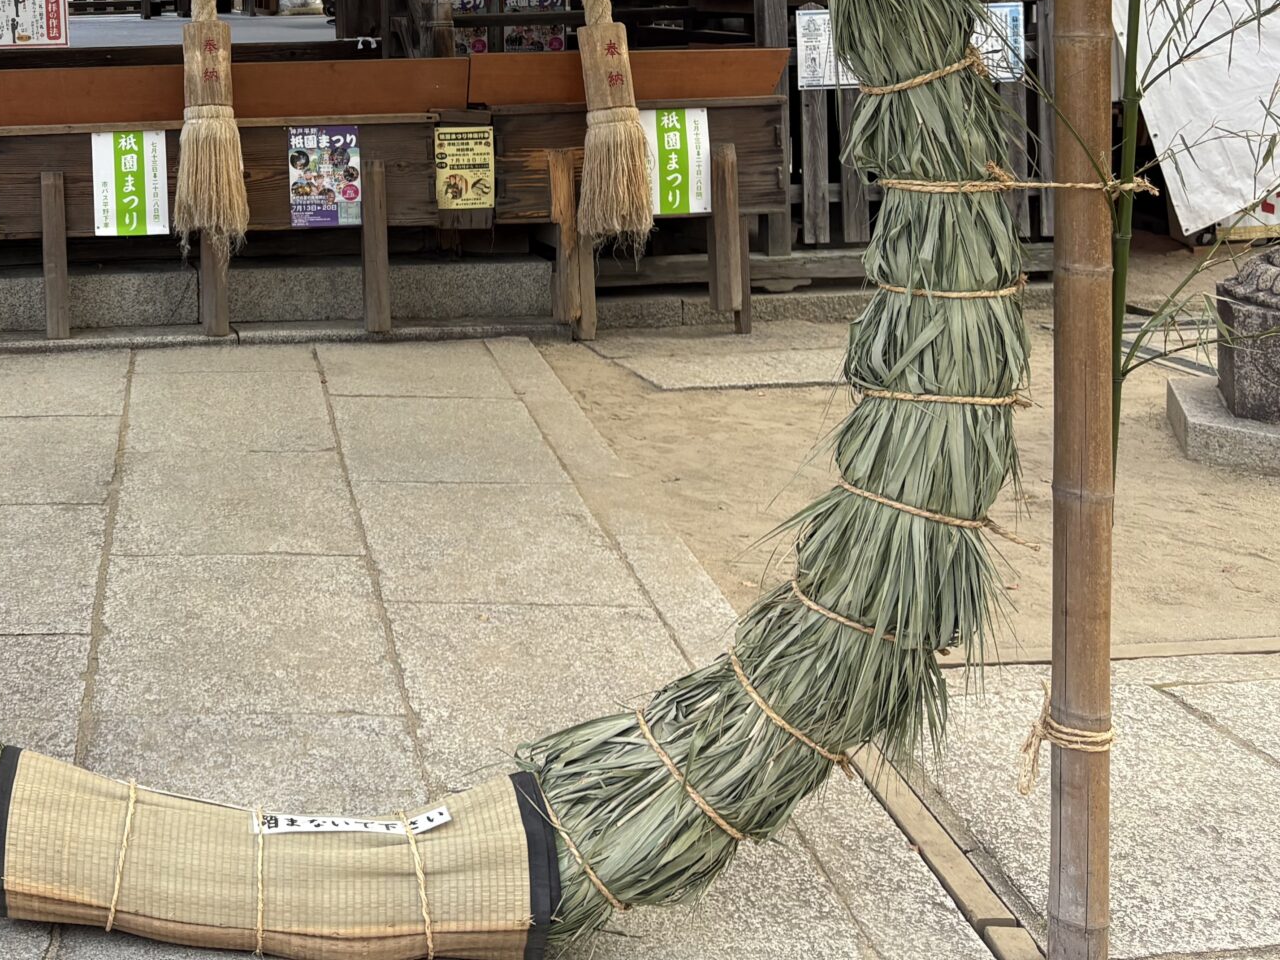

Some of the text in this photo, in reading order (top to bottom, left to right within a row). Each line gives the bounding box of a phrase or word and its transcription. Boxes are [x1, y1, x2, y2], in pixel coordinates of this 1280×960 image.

[203, 36, 219, 83] 奉納
[604, 39, 625, 88] 奉納
[290, 133, 357, 149] 祇園まつり
[660, 111, 683, 209] 祇園まつり
[118, 133, 139, 232] 祇園まつり
